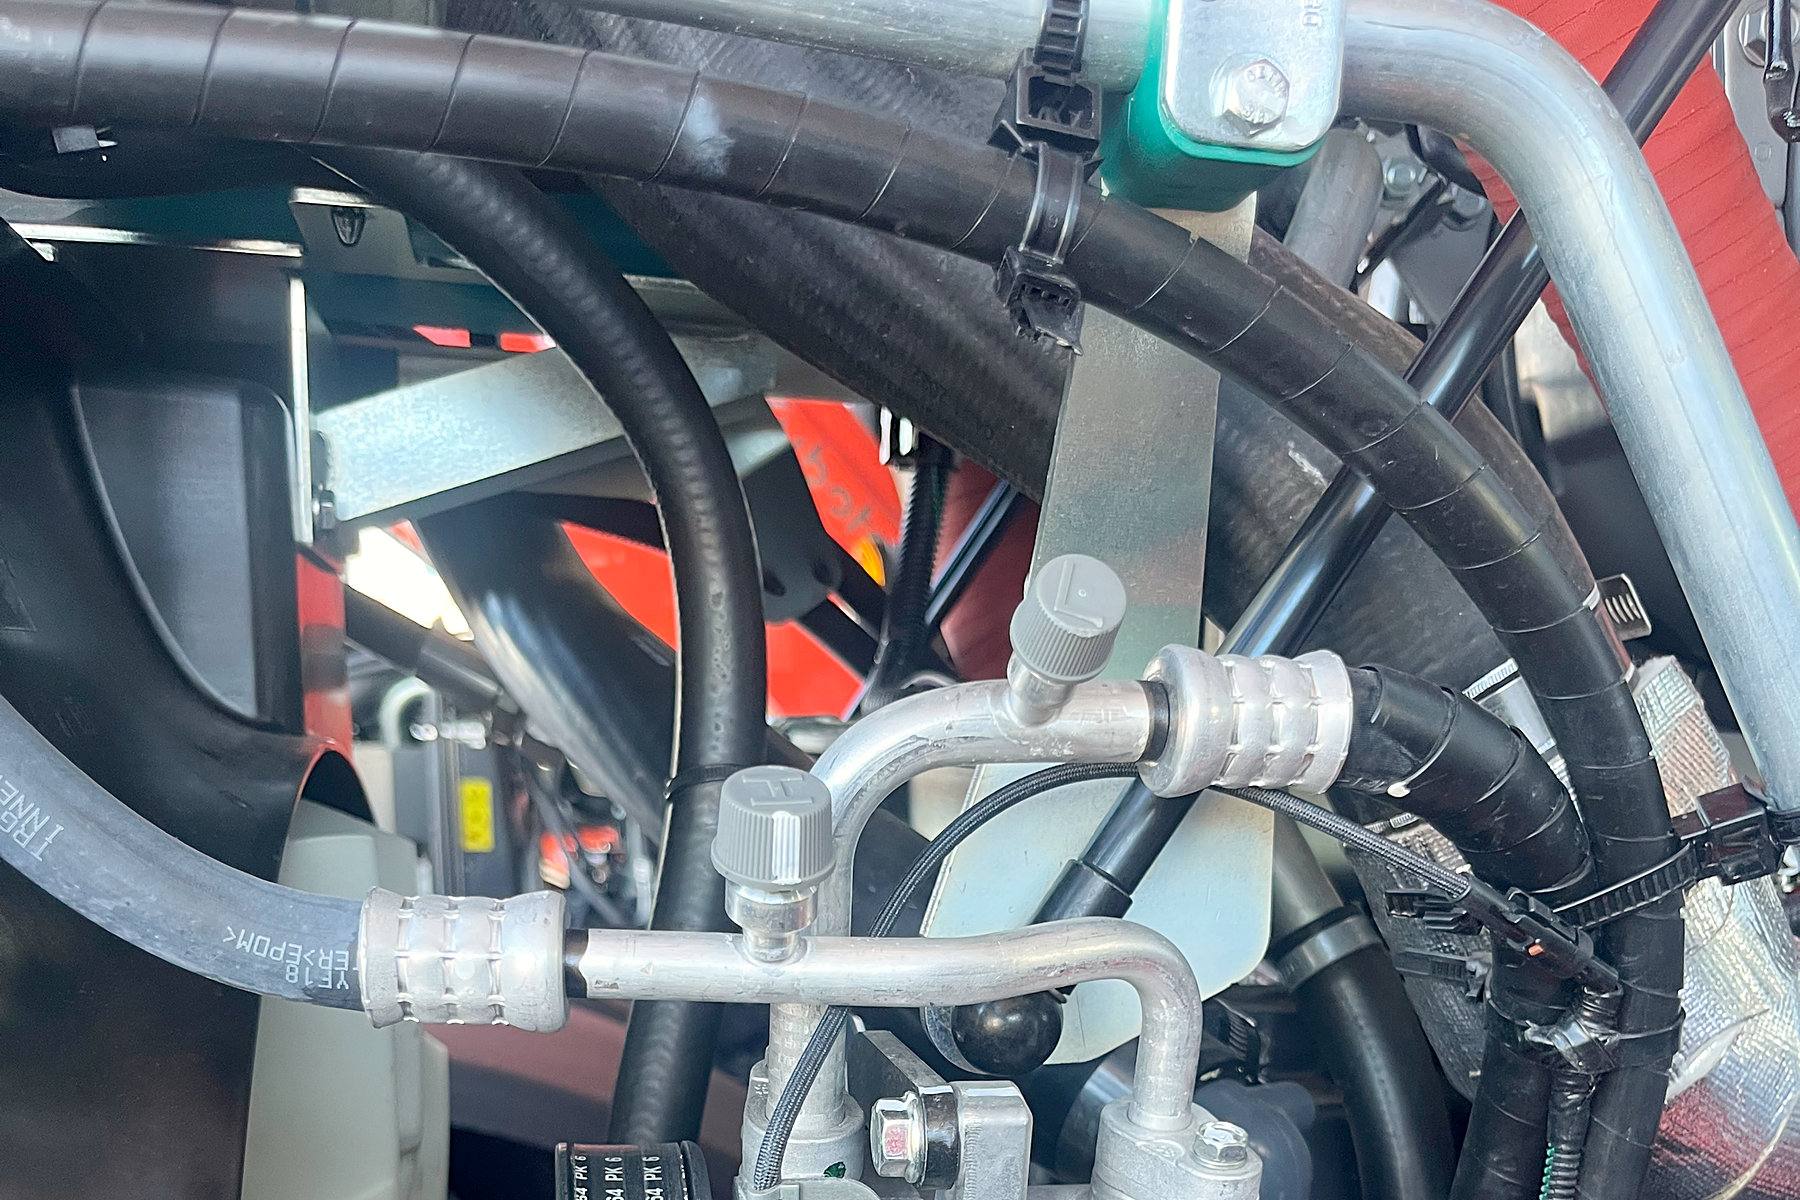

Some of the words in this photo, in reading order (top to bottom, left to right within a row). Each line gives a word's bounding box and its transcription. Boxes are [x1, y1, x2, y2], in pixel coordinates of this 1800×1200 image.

[0, 775, 65, 832] INNE
[223, 925, 358, 972] ER>EPDM<
[604, 1166, 624, 1182] PK
[643, 1165, 663, 1182] PK
